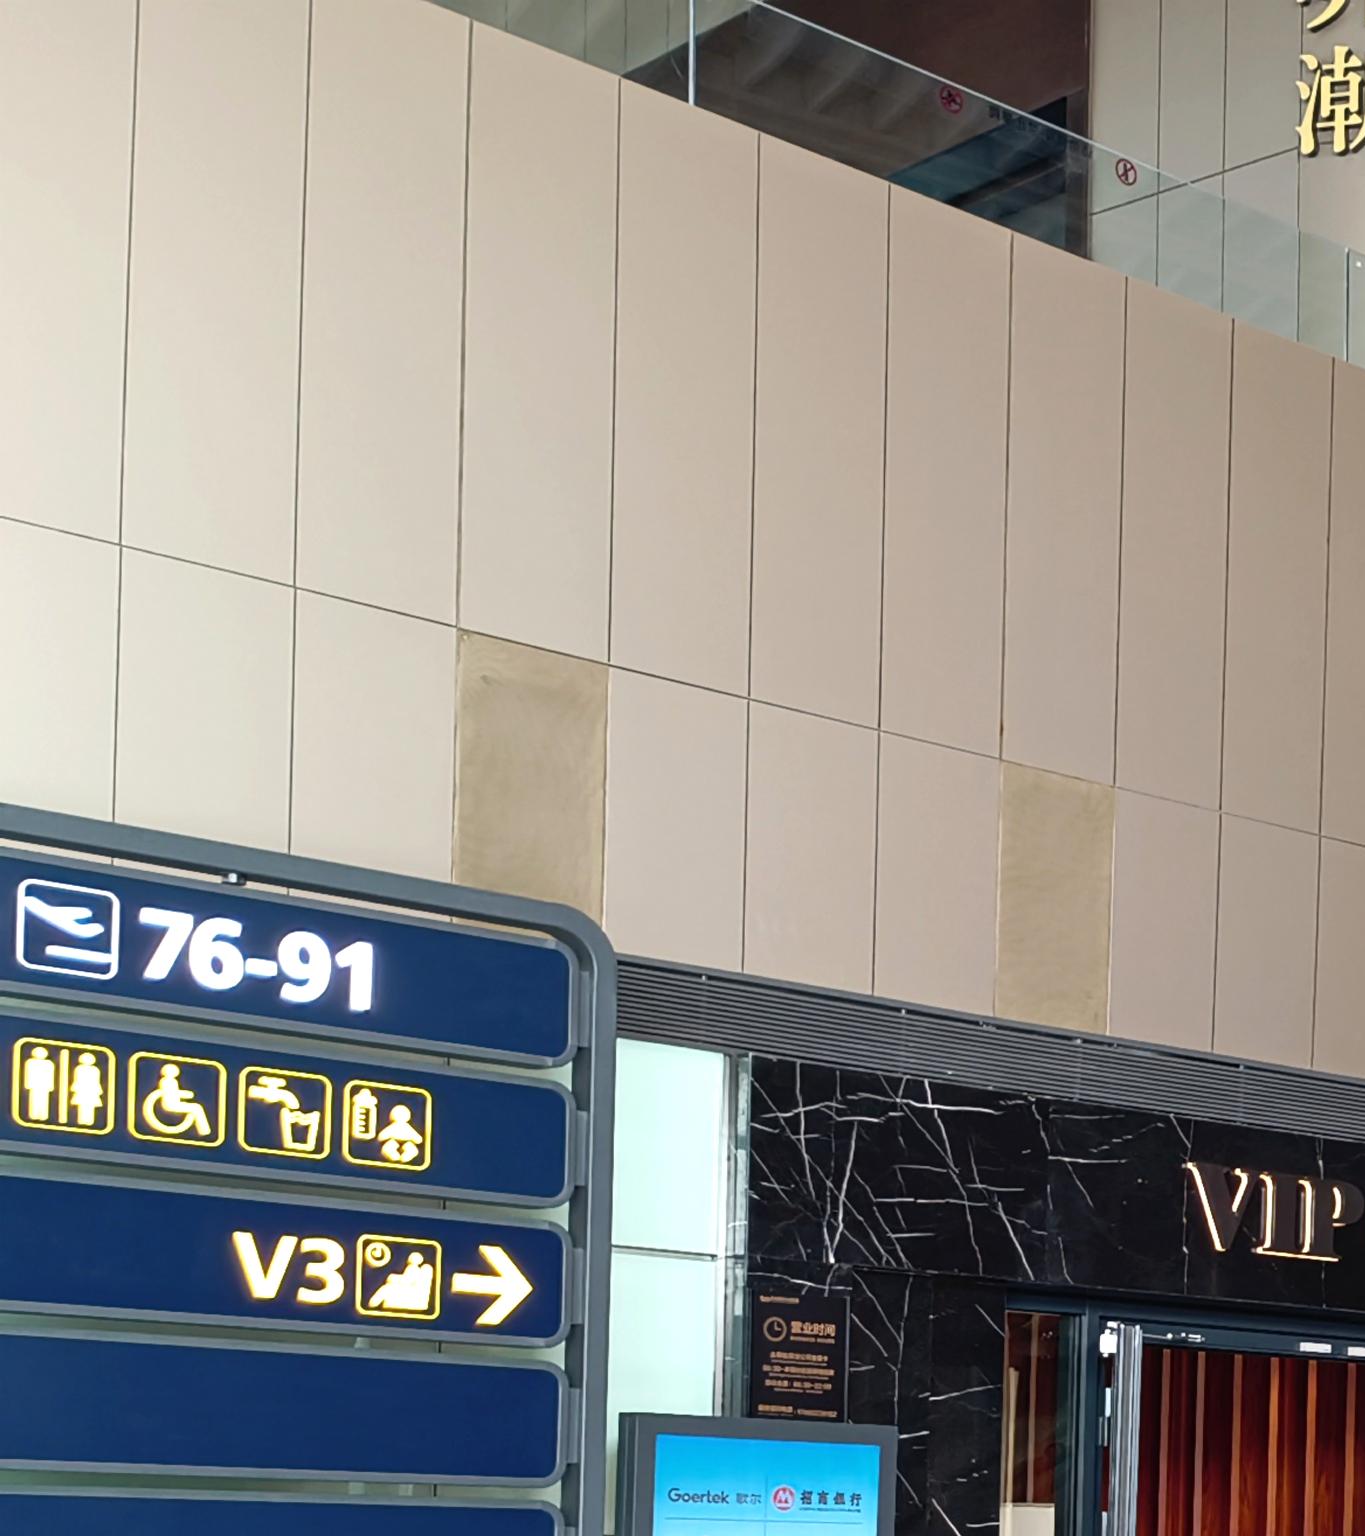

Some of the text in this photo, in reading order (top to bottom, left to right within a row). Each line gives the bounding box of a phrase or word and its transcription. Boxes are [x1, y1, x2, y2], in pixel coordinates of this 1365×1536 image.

[139, 907, 374, 1012] 76-91
[1183, 1161, 1364, 1262] VIP
[232, 1231, 346, 1305] V3
[668, 1487, 729, 1504] Goertek
[736, 1493, 762, 1504] 歌尔
[800, 1490, 862, 1506] 招商银行
